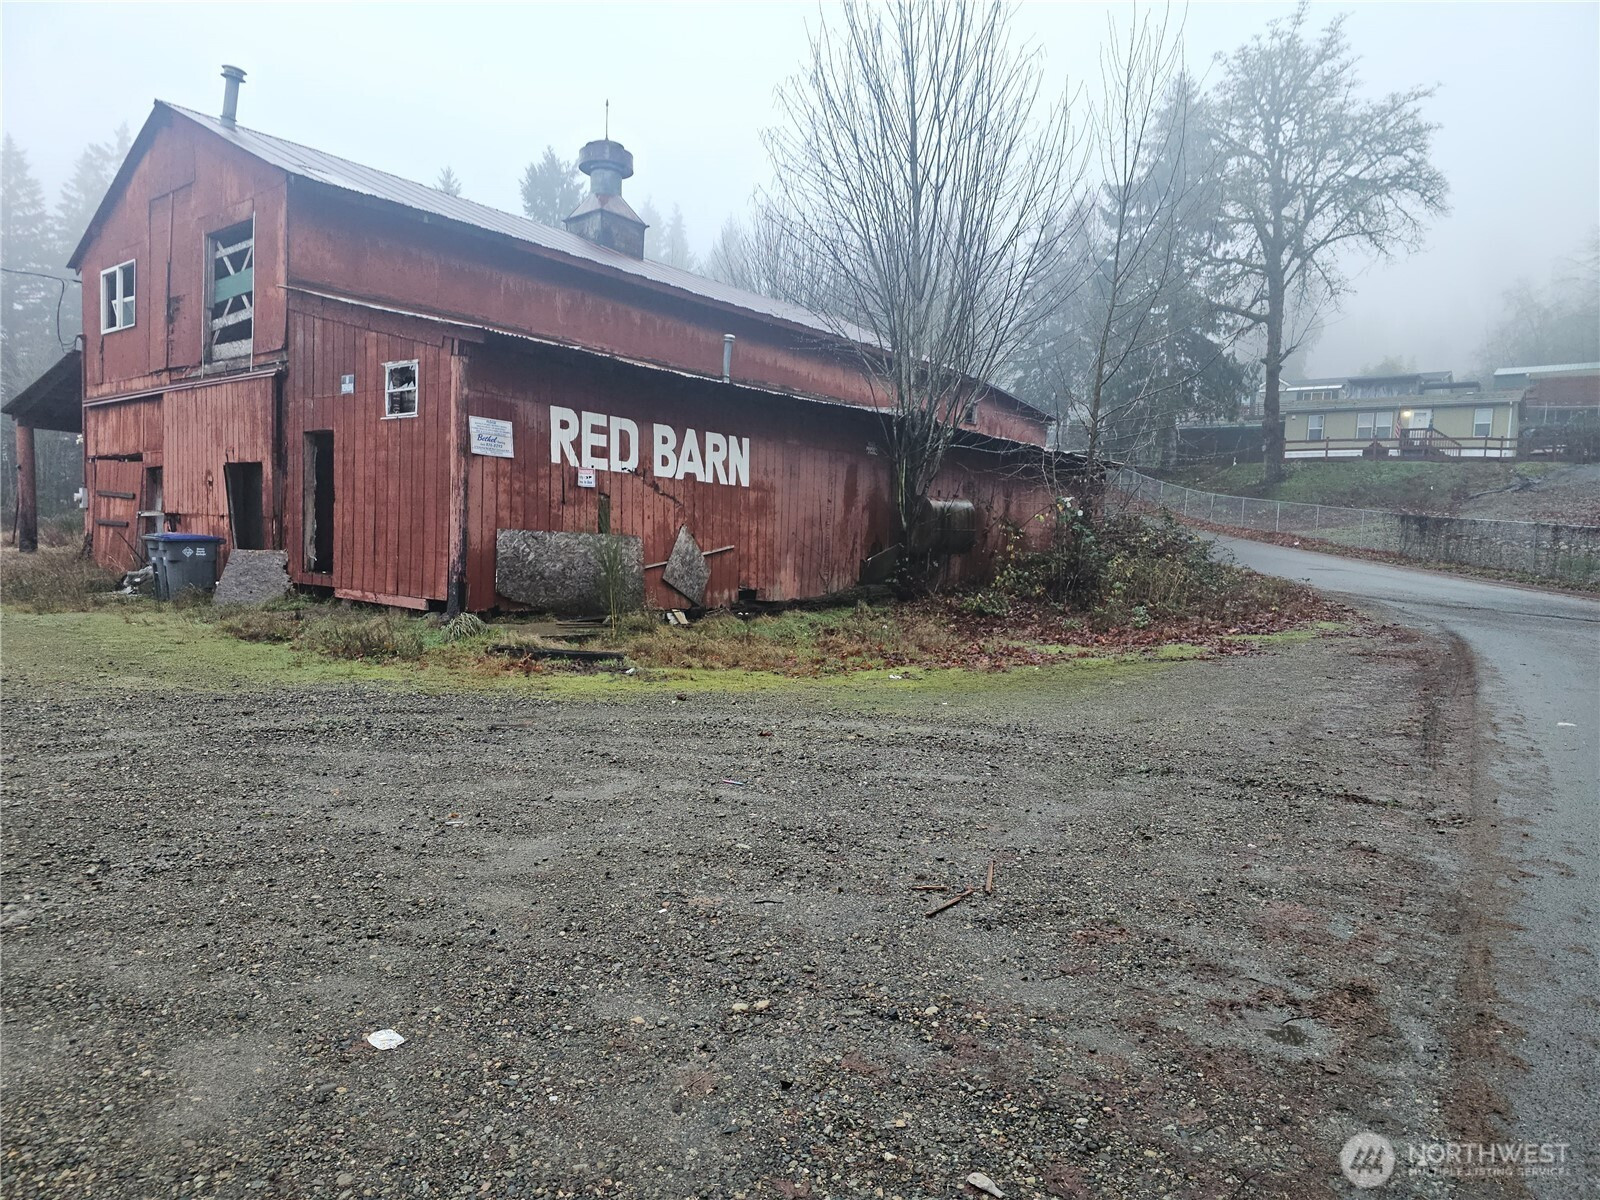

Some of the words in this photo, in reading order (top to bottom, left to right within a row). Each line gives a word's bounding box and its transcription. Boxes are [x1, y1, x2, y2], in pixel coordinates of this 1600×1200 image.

[477, 434, 498, 443] Bethel
[550, 405, 639, 474] RED
[653, 423, 750, 487] BARN
